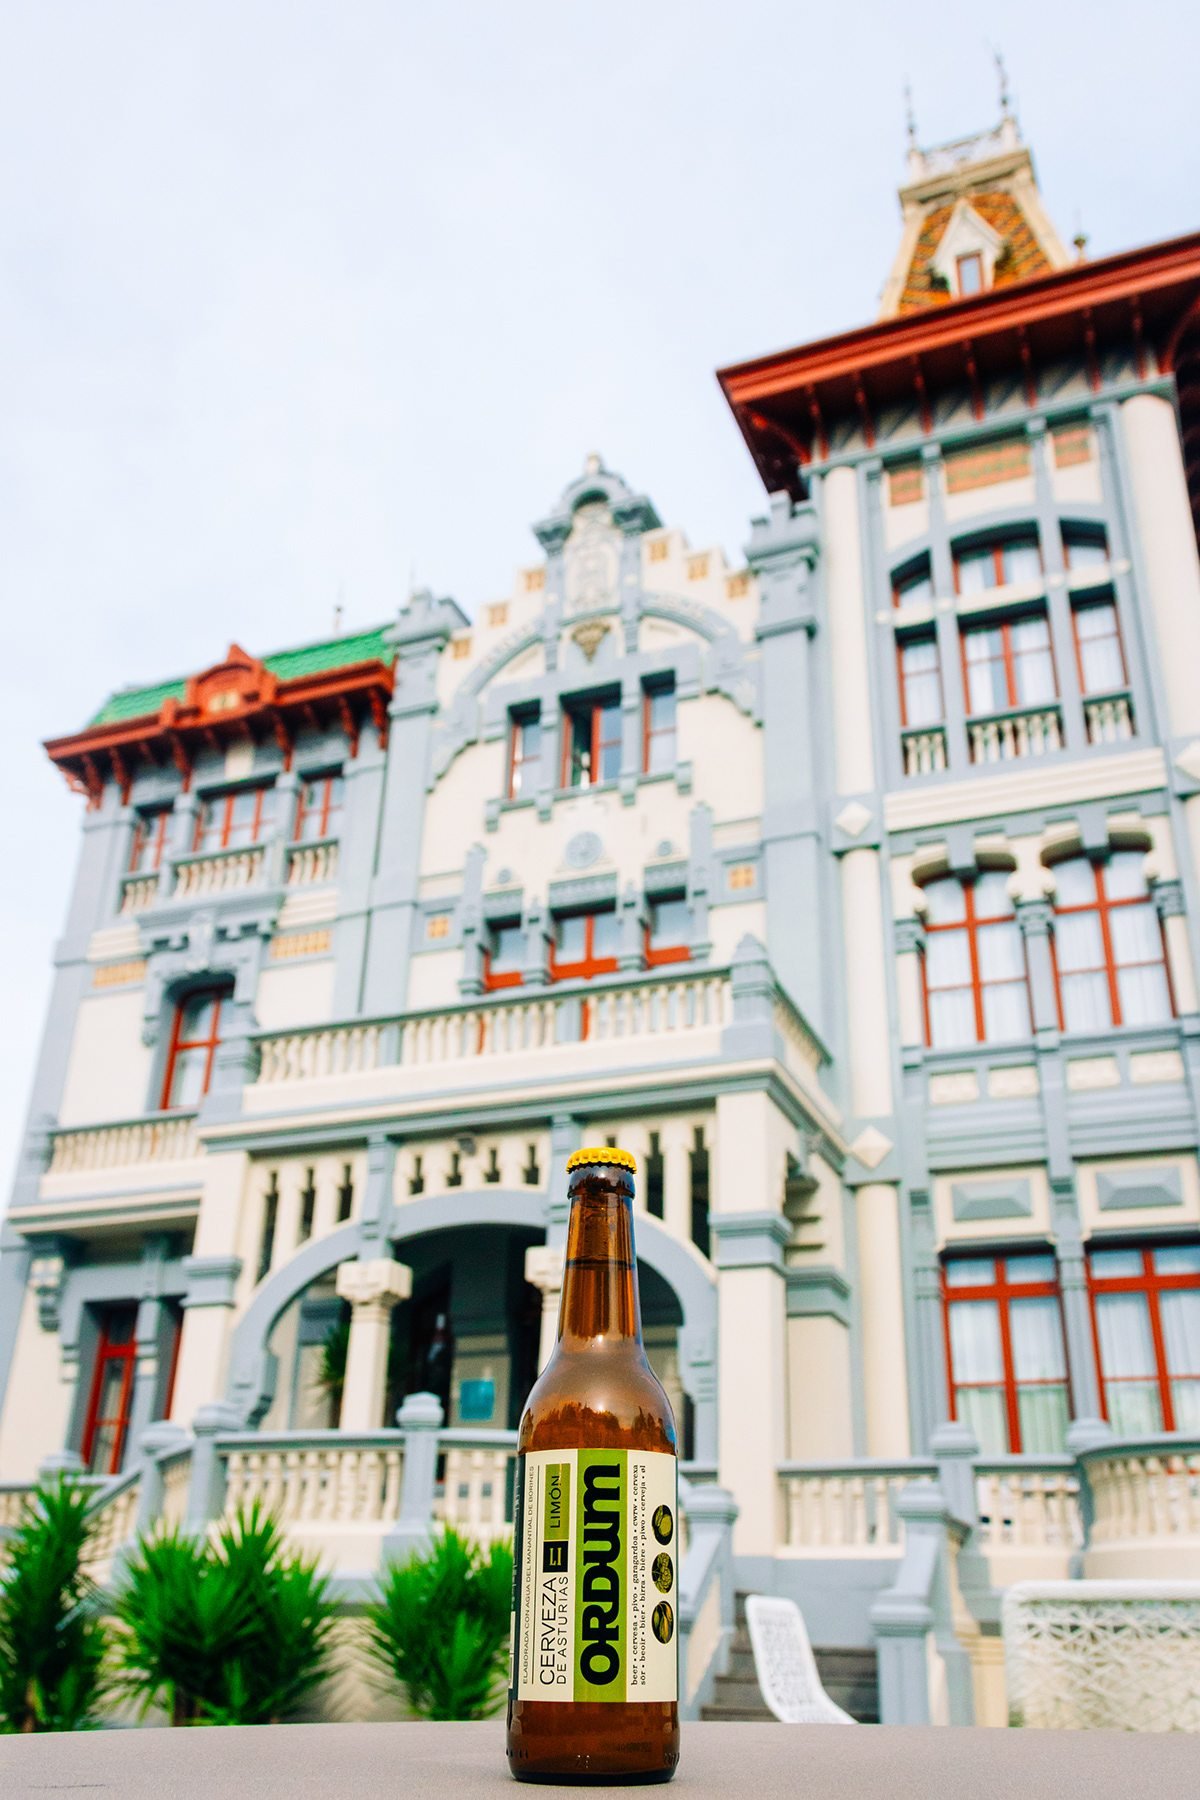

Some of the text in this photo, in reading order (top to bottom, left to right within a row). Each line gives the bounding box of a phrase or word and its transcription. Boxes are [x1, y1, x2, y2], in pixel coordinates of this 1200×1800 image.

[528, 1504, 533, 1516] DE
[548, 1476, 562, 1528] LIMÓN
[540, 1577, 556, 1685] CERVEZA
[556, 1576, 568, 1684] DE ASTURIAS
